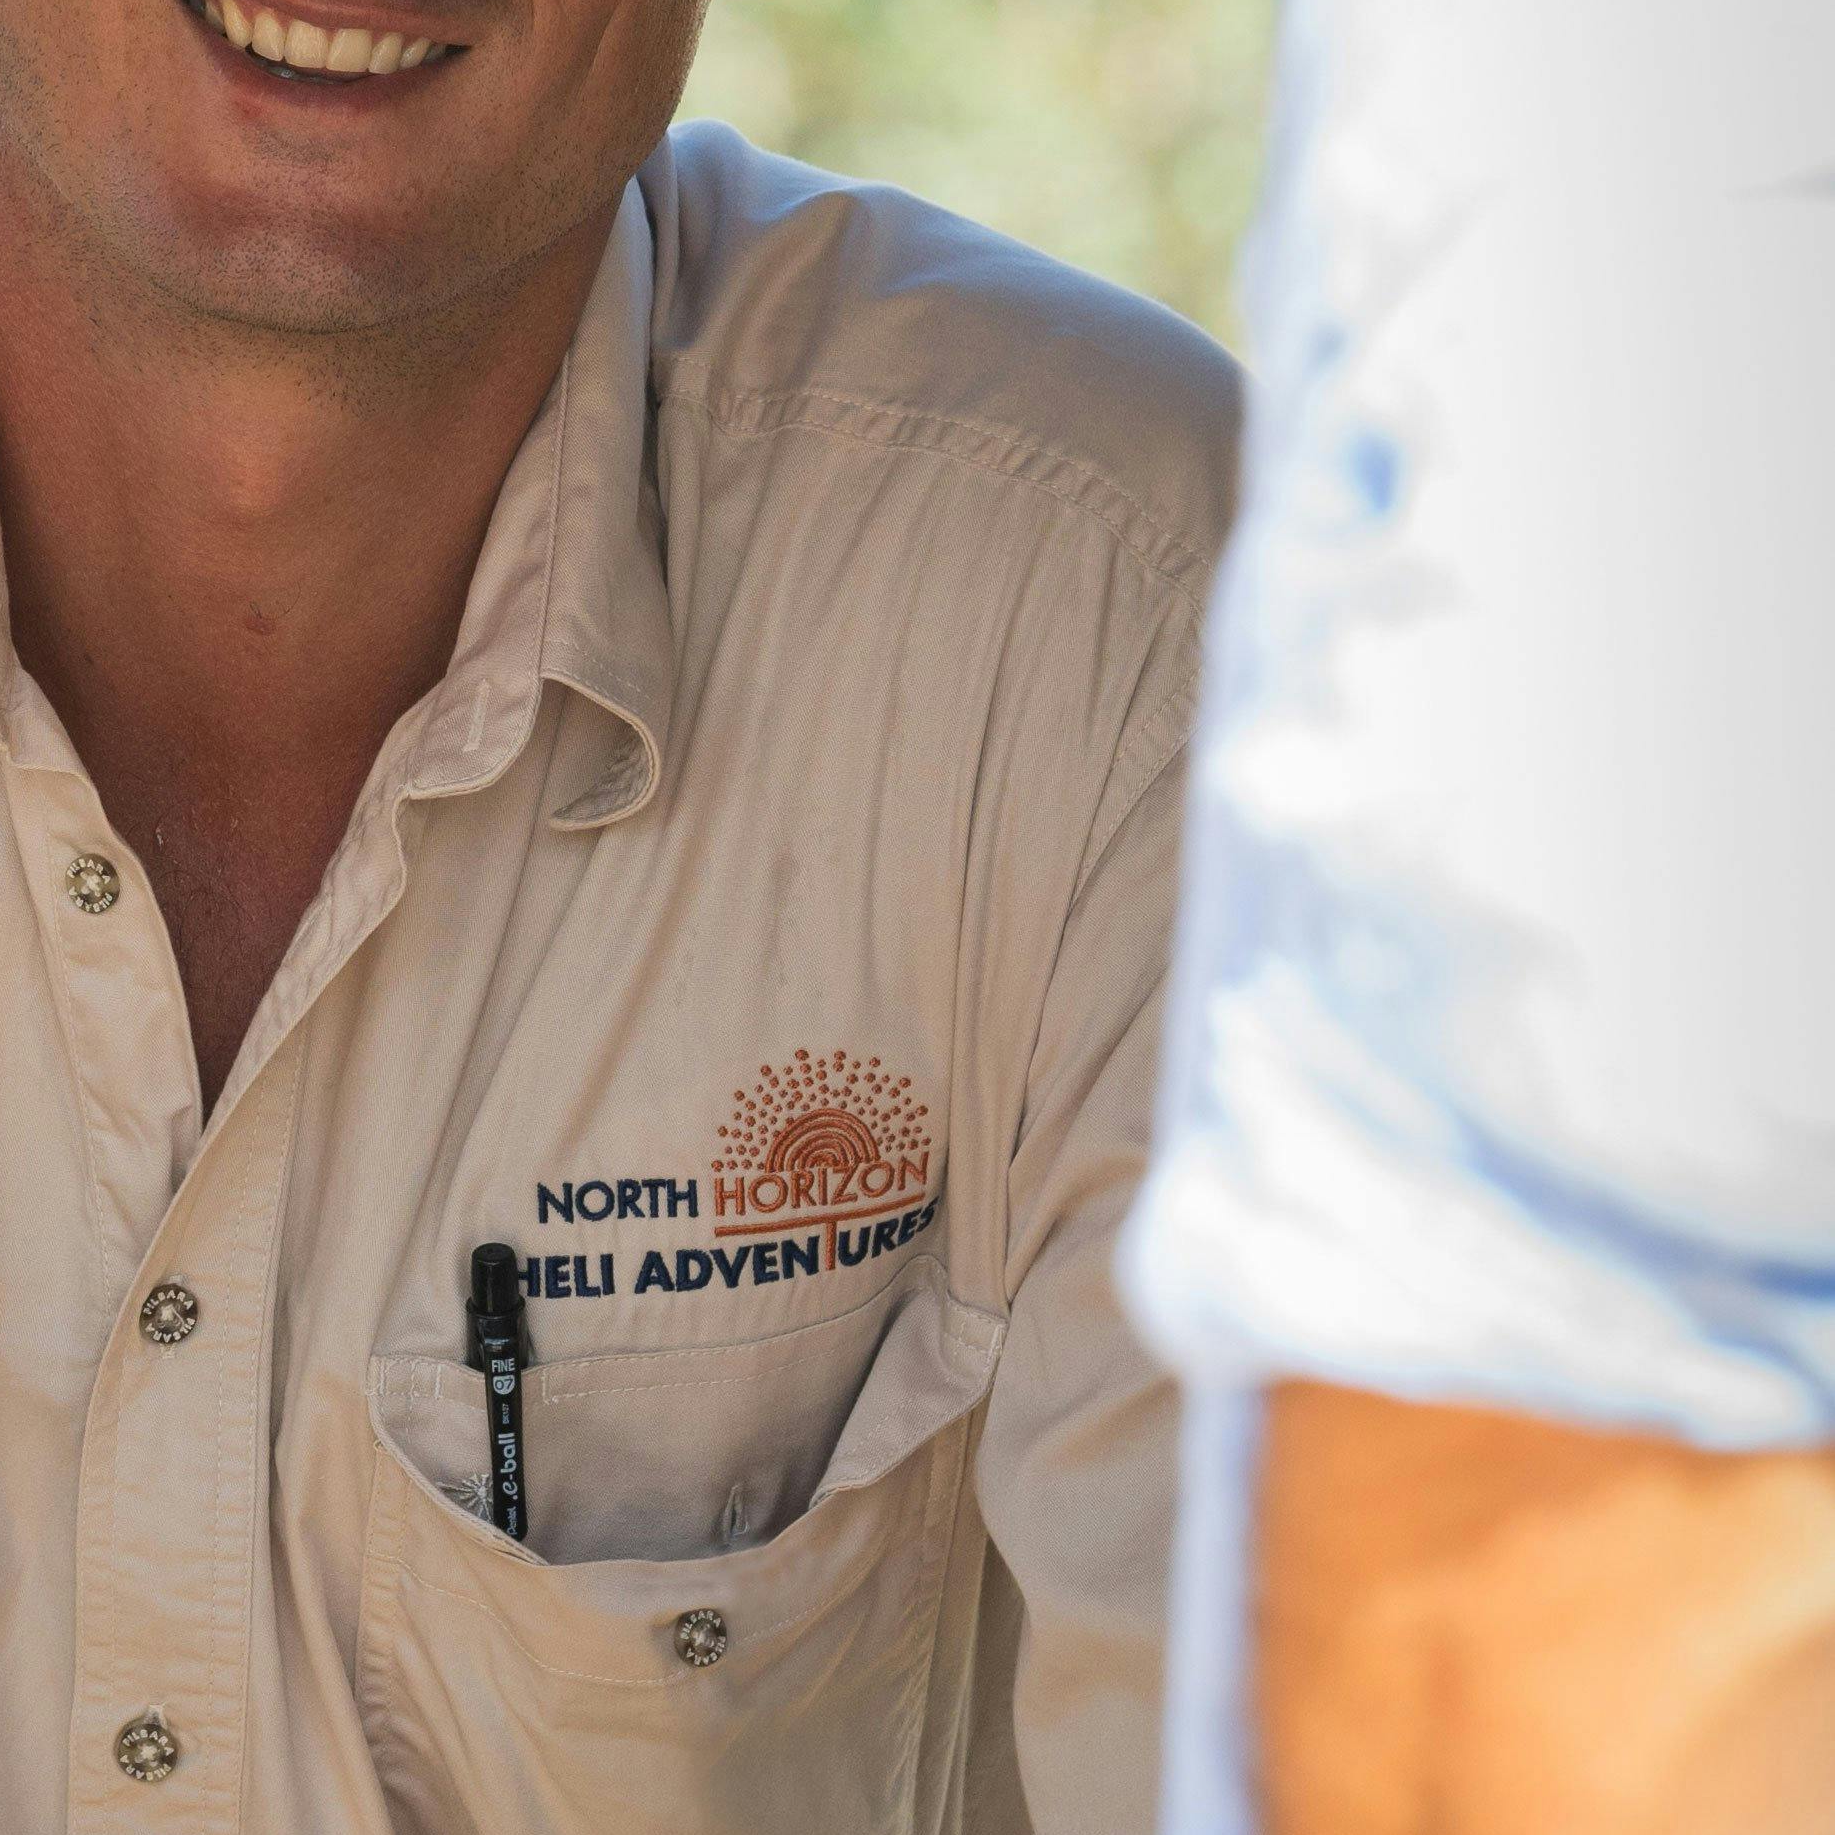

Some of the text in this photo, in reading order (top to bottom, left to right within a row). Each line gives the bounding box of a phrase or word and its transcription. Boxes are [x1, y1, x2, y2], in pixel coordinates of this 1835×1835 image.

[537, 1151, 929, 1223] NORTH HORIZON
[635, 1195, 939, 1295] ADVENTURES
[491, 1358, 516, 1373] FINE
